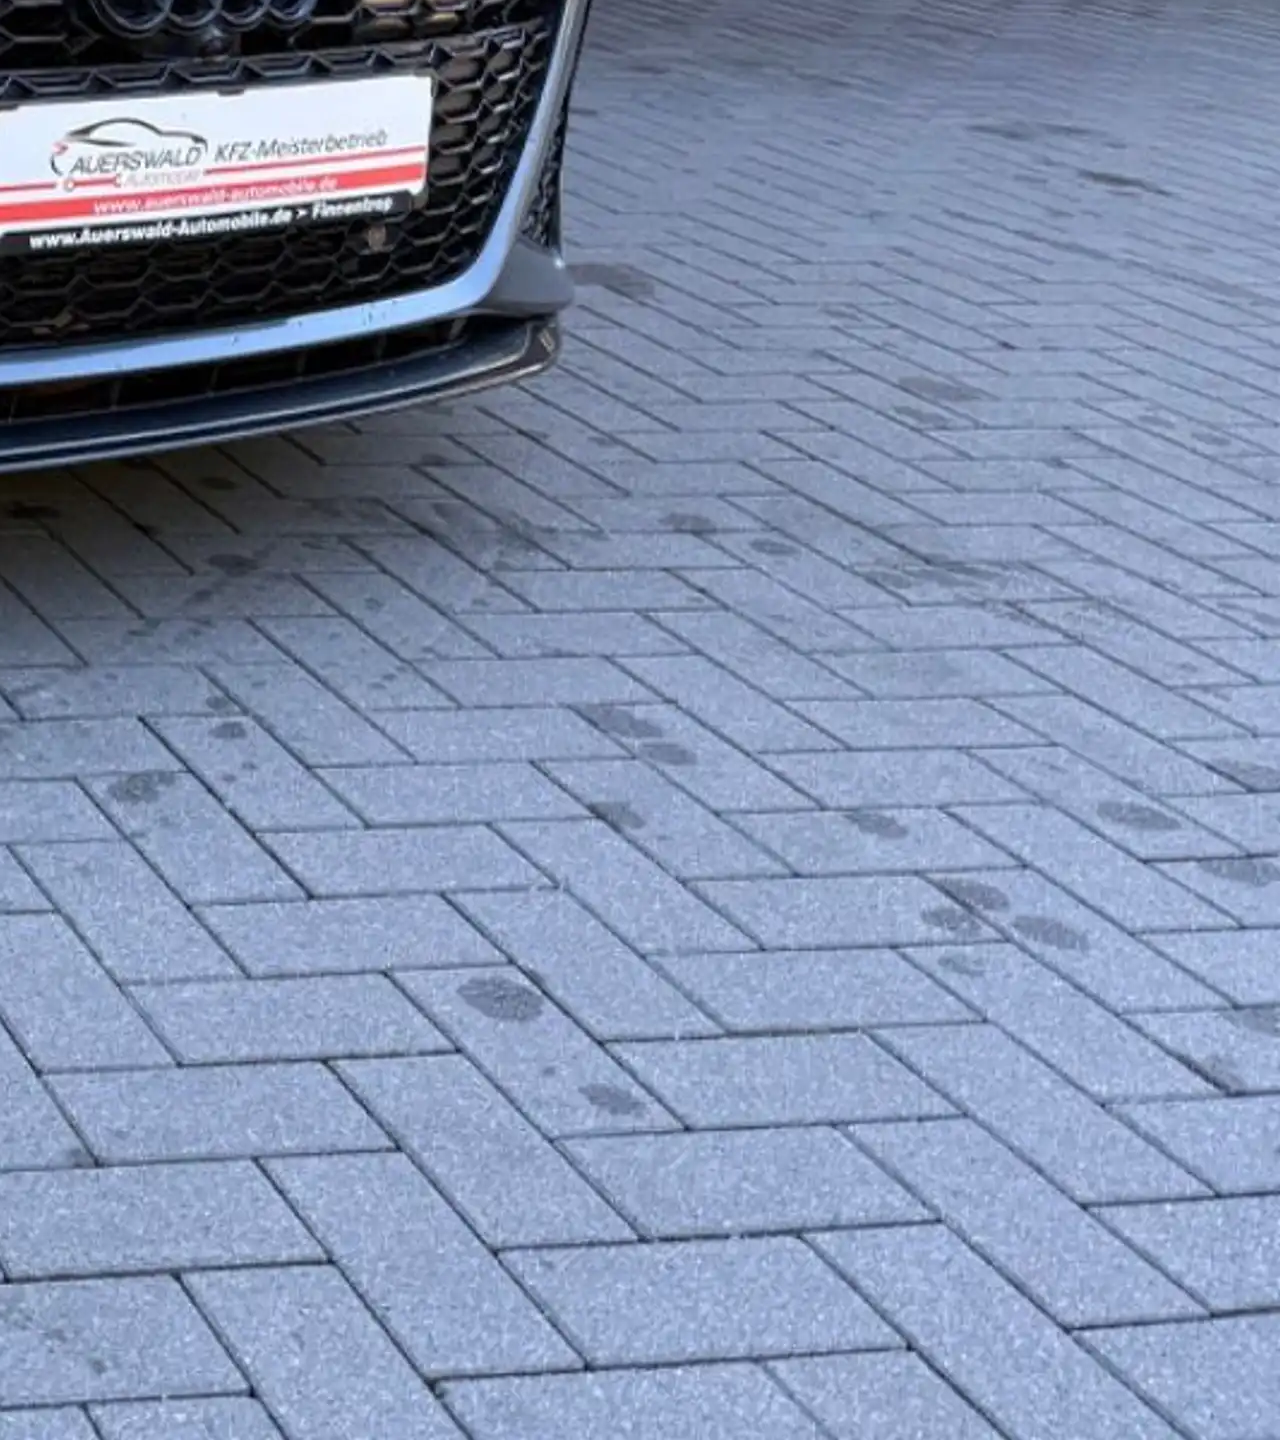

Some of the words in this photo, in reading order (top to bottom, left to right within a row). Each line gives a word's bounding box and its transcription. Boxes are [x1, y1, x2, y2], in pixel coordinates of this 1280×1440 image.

[70, 146, 202, 175] AUERSWALD
[93, 175, 338, 217] www.auerswald-automobile.de
[29, 207, 292, 250] www.Auerswald-Automobile.de
